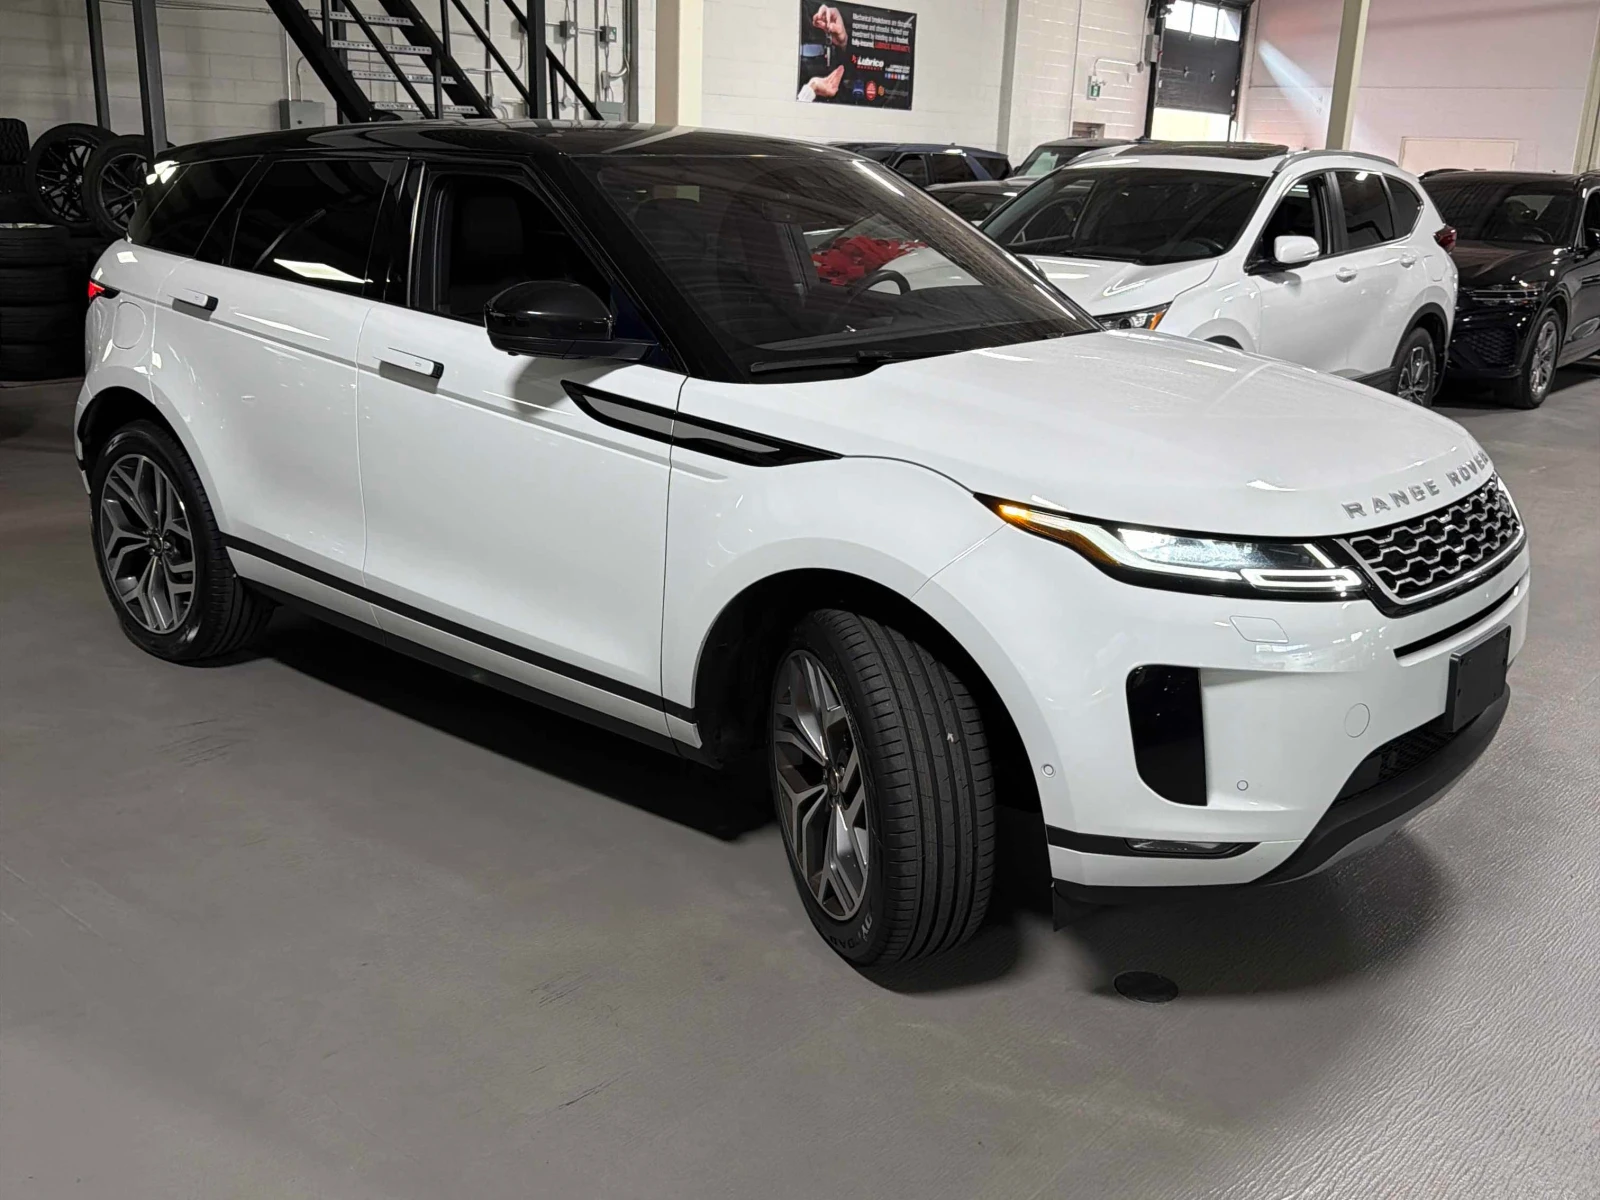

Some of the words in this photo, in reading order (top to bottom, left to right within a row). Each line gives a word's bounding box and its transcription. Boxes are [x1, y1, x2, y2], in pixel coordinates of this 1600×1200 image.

[857, 56, 884, 68] Lubrico
[1341, 479, 1440, 519] RANGE
[1446, 451, 1489, 487] ROVER
